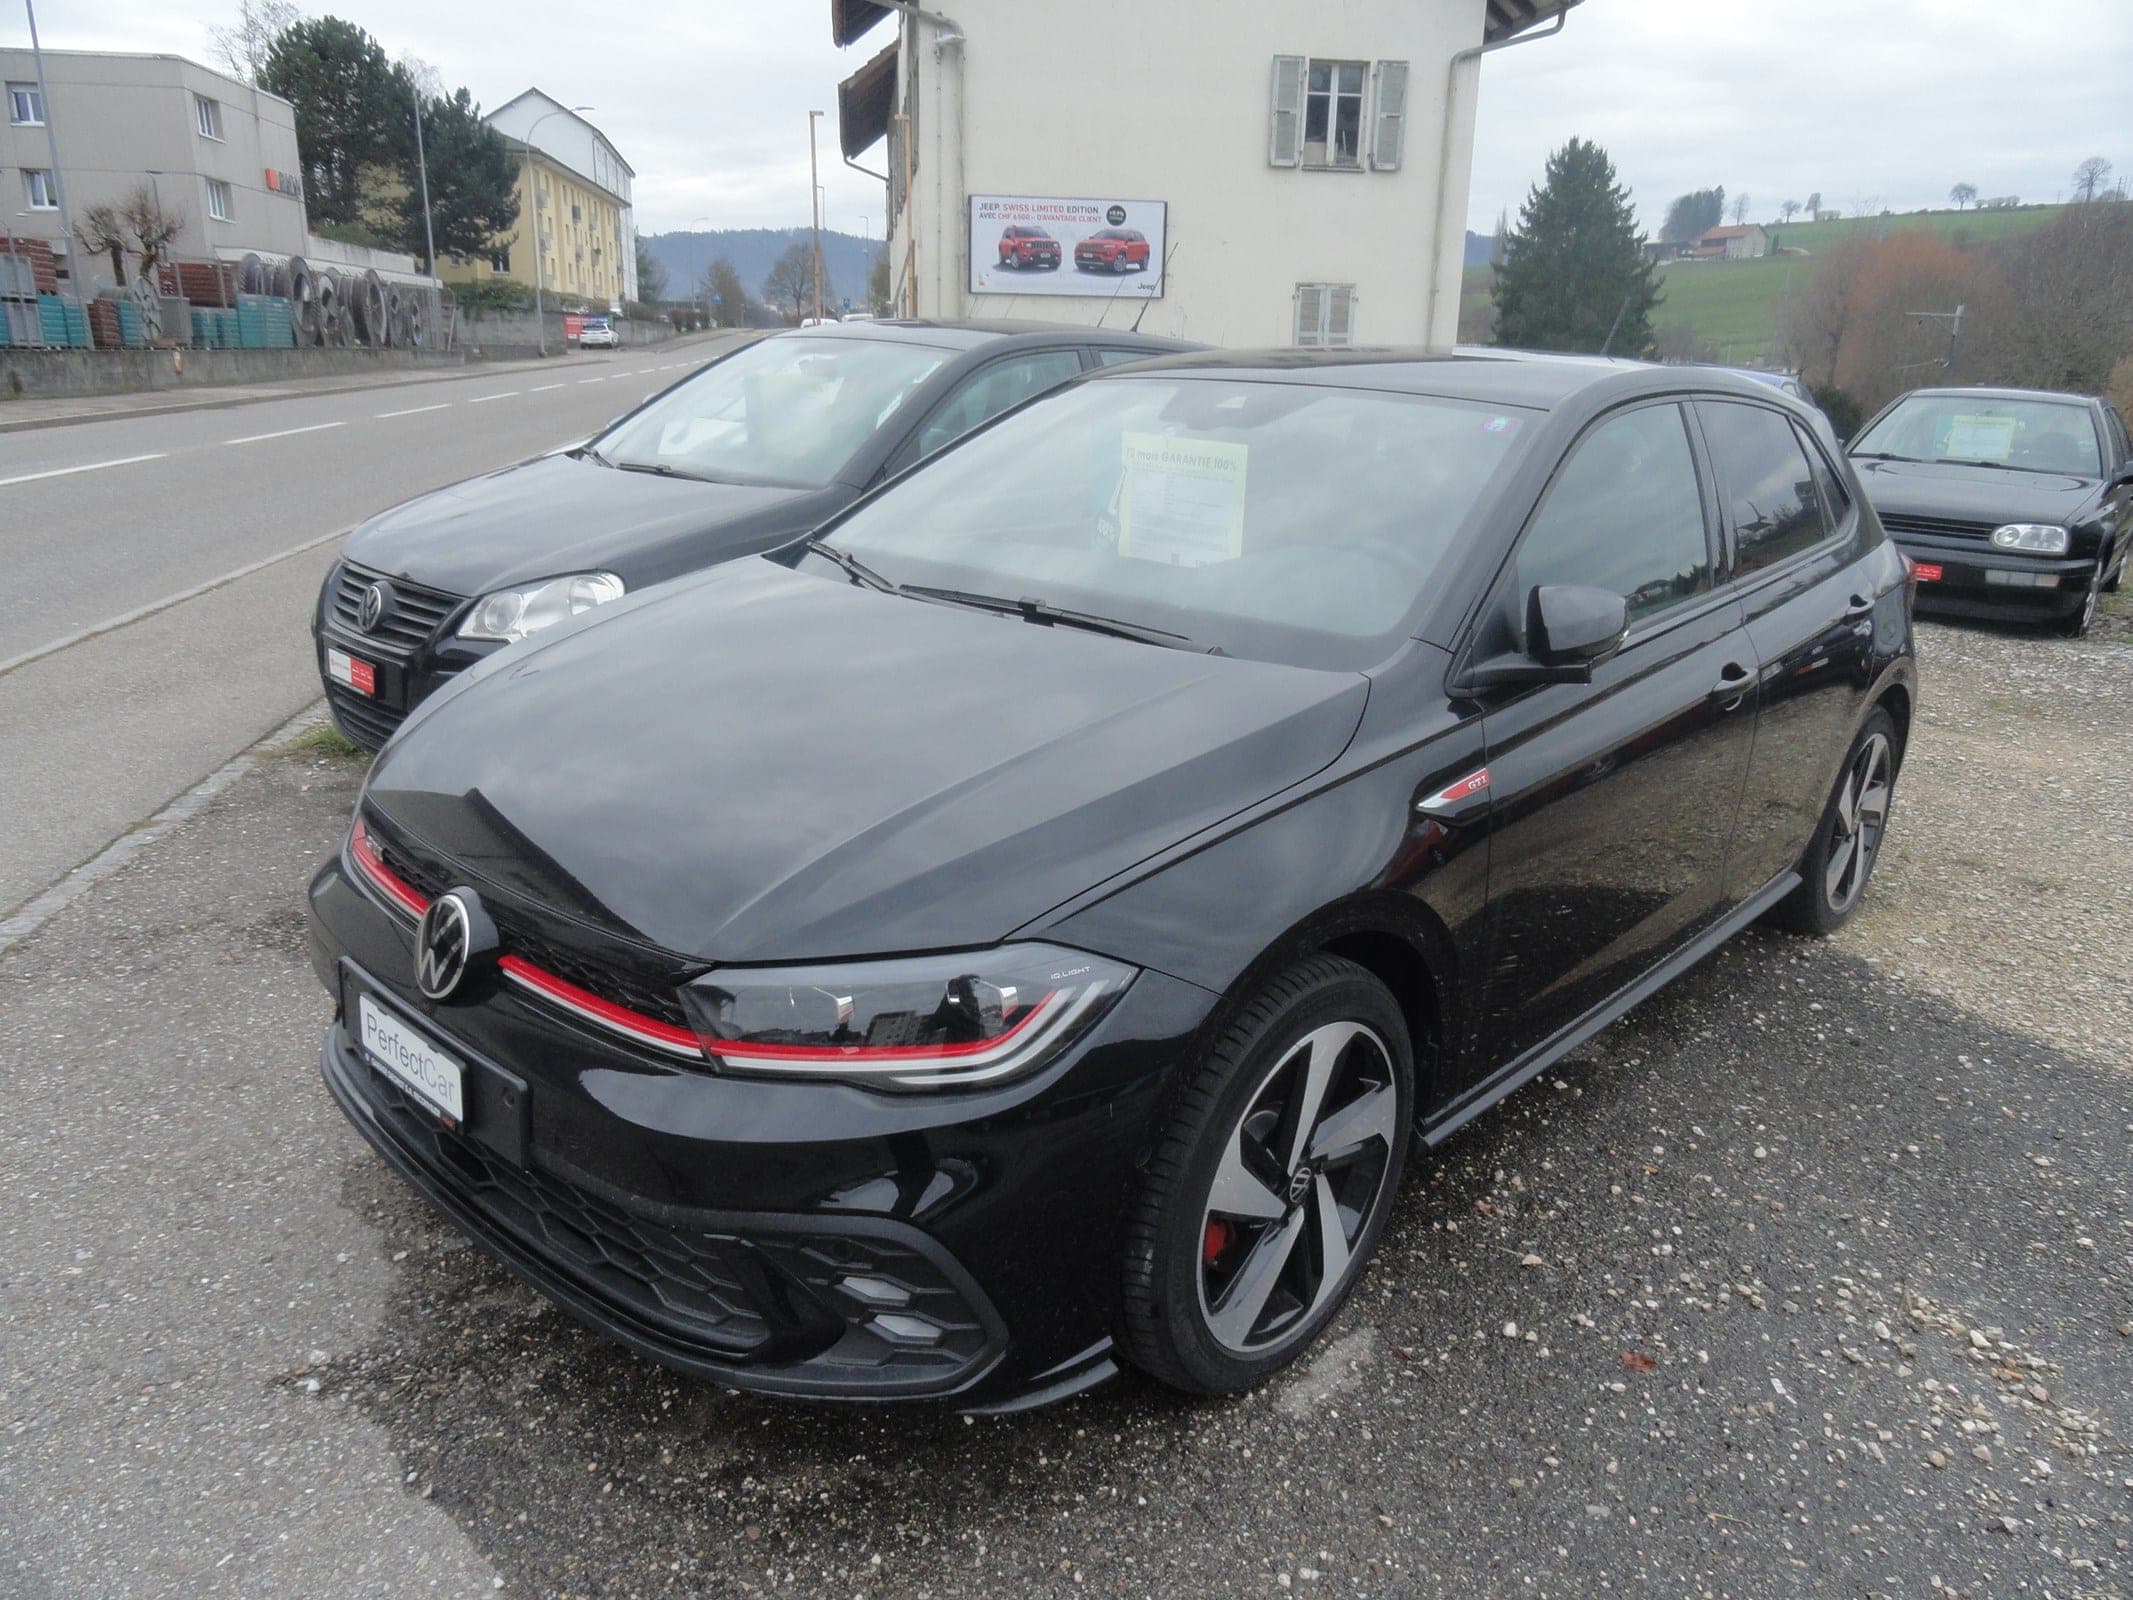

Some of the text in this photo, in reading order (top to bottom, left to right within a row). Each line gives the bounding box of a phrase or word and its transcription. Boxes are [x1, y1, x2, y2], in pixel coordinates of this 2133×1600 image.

[979, 202, 1000, 211] JEEP
[1003, 203, 1030, 213] SWISS
[1031, 204, 1065, 213] LIMITED
[1066, 205, 1099, 214] EDITION
[1137, 282, 1156, 292] Jeep
[1467, 775, 1488, 791] GTI
[366, 1011, 455, 1102] PerfectCar
